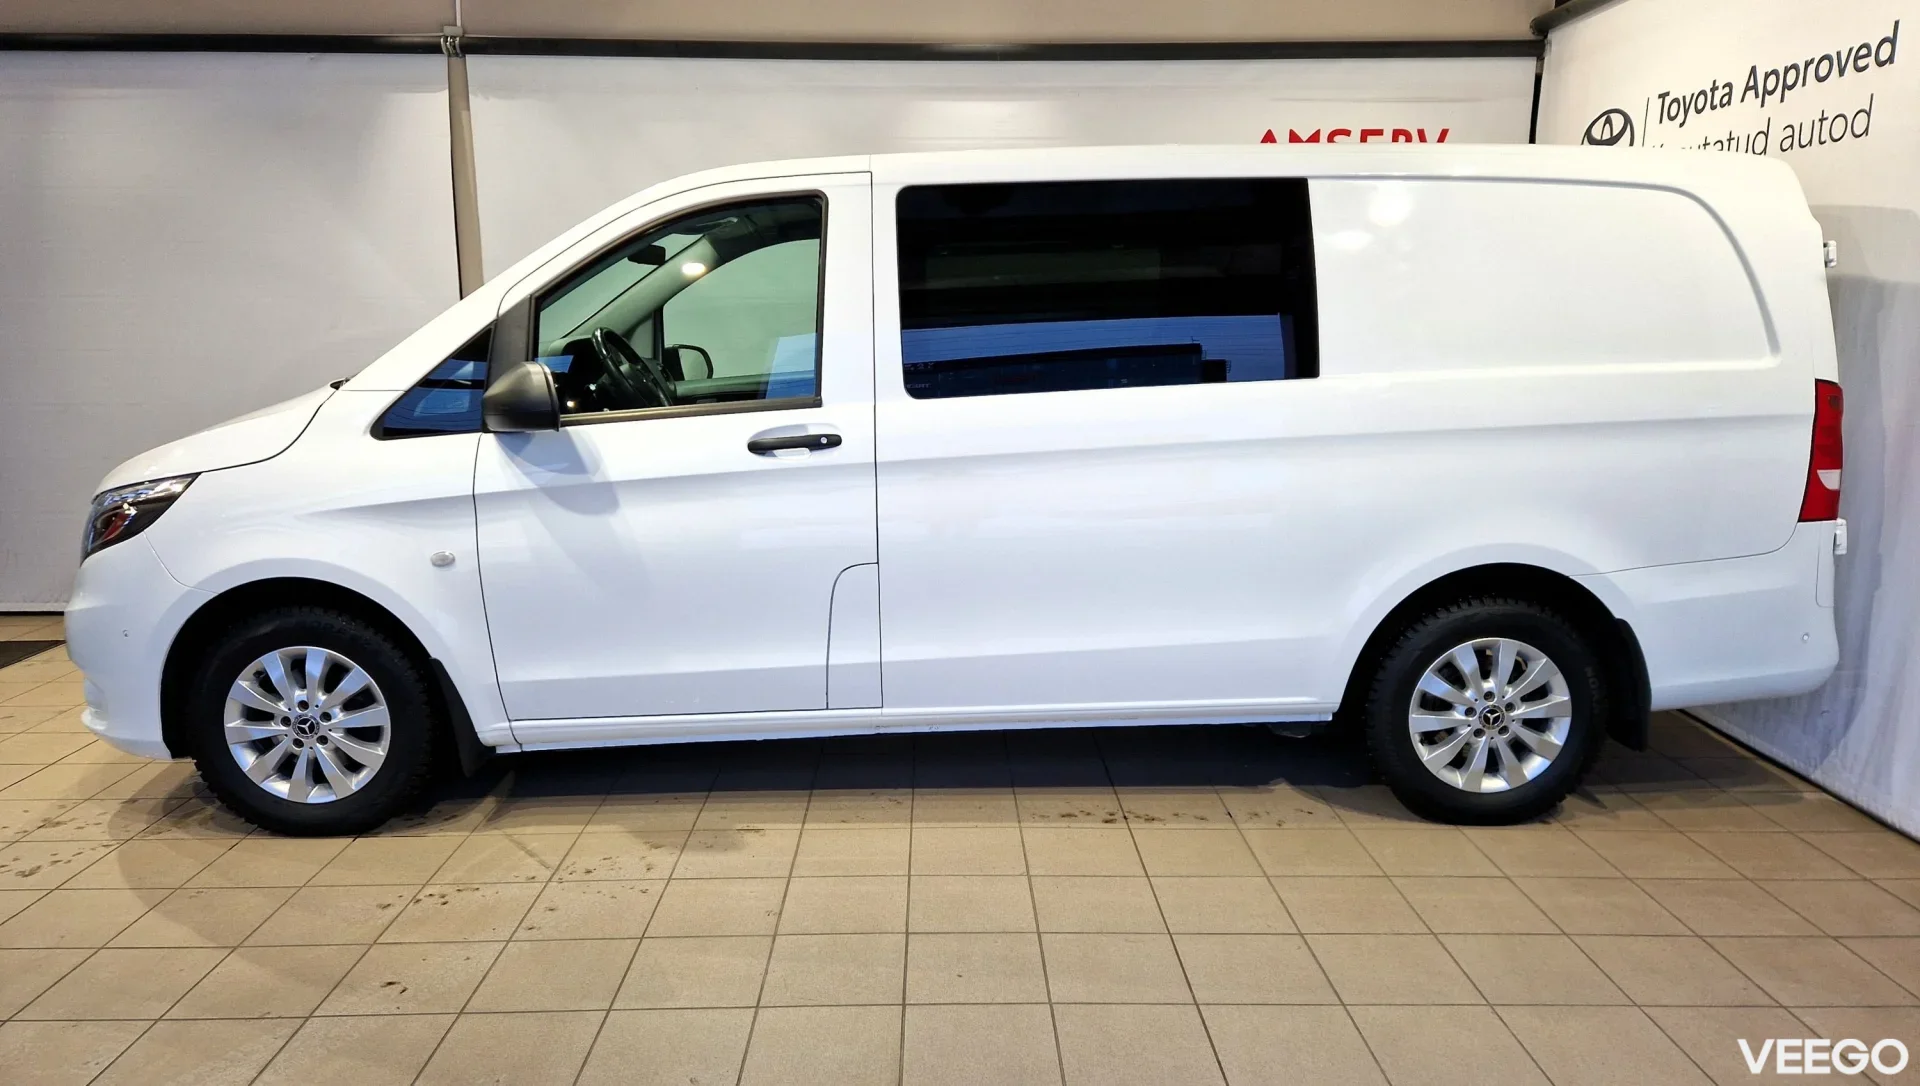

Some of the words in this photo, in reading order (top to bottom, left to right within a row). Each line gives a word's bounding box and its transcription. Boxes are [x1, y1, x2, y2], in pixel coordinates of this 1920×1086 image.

[1657, 80, 1733, 128] Toyota
[1741, 20, 1900, 108] Approved
[1780, 94, 1874, 153] autod
